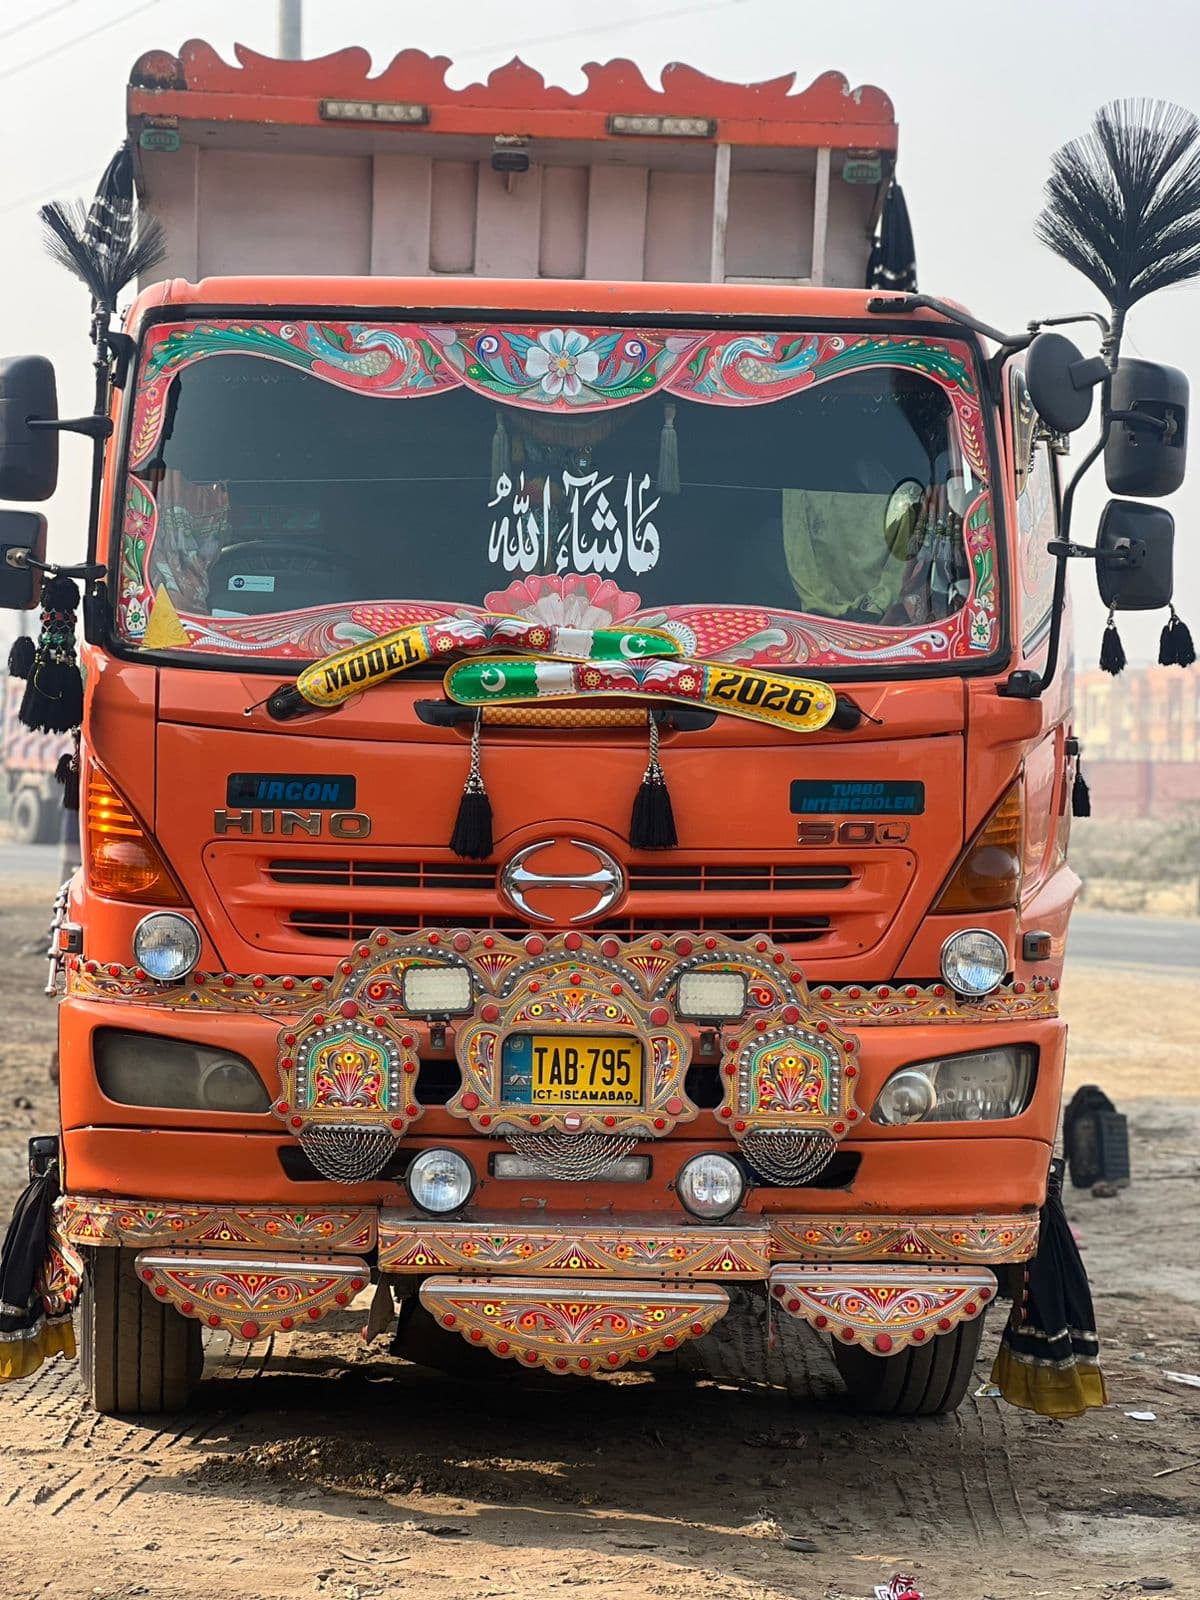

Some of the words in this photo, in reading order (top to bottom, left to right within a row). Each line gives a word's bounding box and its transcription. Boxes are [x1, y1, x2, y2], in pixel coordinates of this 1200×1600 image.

[324, 637, 419, 693] MODEL
[712, 672, 814, 716] 2026
[240, 781, 340, 802] IRCON
[832, 783, 885, 795] TURBO
[801, 797, 915, 811] INTERCOOLER
[214, 809, 371, 838] HINO
